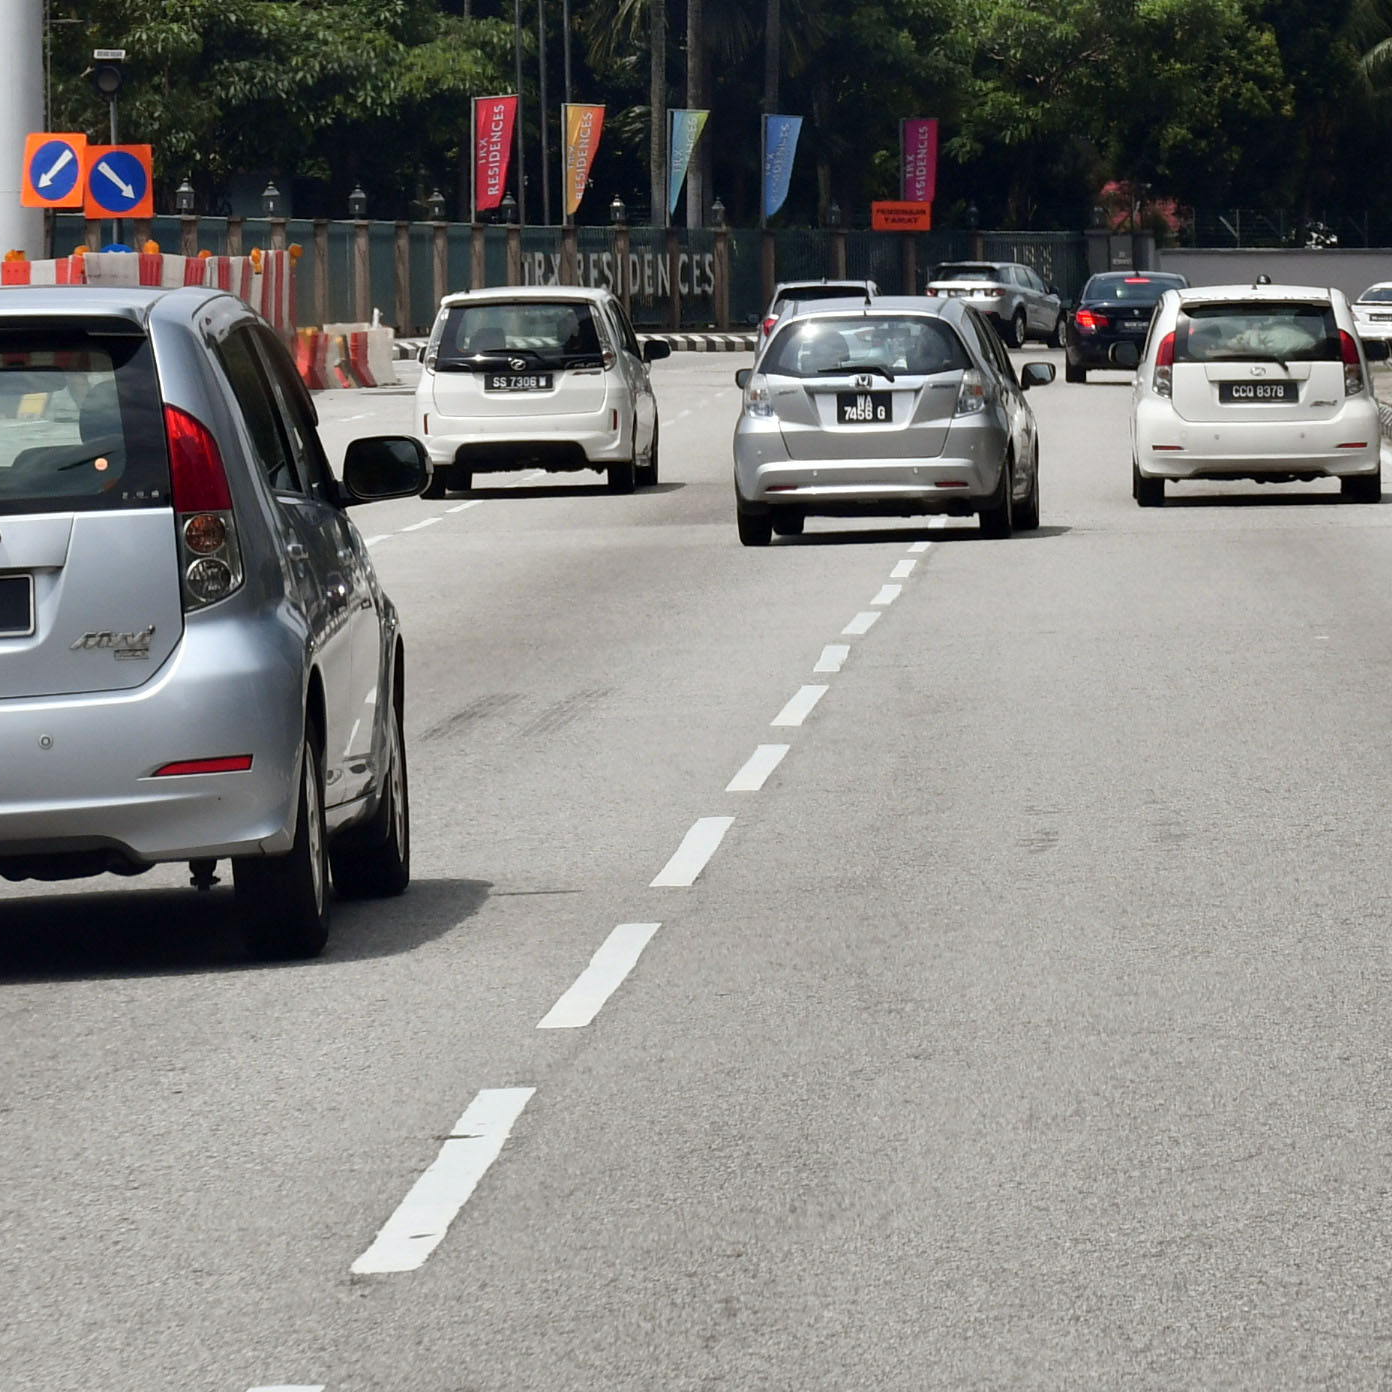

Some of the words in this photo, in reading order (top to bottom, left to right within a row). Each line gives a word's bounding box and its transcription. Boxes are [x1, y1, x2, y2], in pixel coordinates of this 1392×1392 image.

[487, 104, 506, 196] RESIDENCES
[575, 111, 594, 200] RESIDENCES
[492, 376, 507, 387] SS
[510, 376, 537, 387] 7306
[1232, 385, 1254, 397] CCQ
[1256, 385, 1284, 397] 8378
[856, 394, 873, 407] WA
[844, 406, 873, 421] 7456
[877, 406, 886, 420] G
